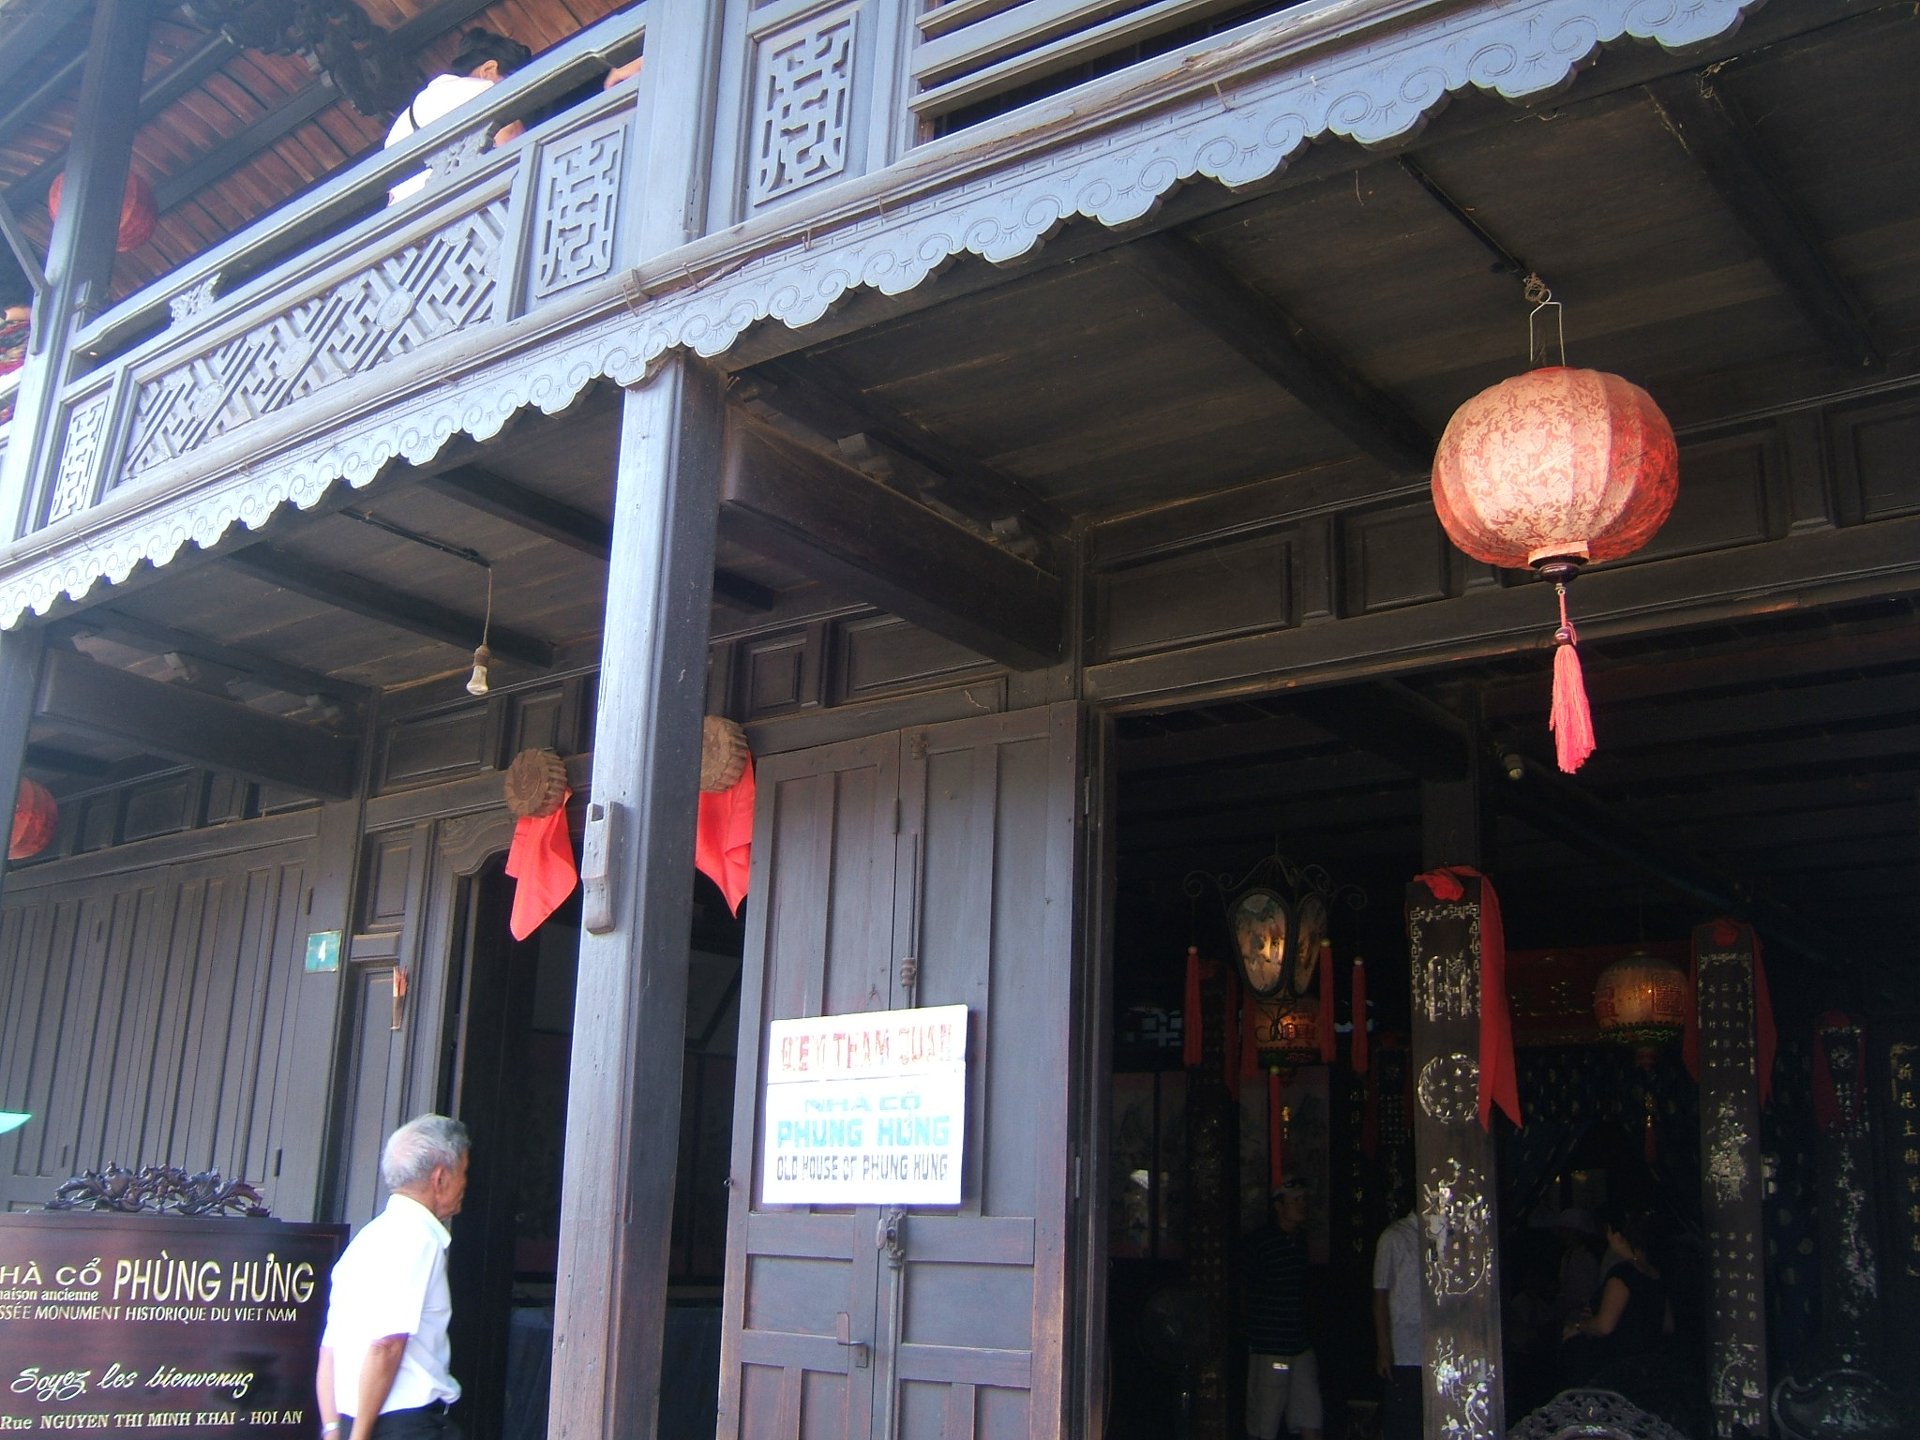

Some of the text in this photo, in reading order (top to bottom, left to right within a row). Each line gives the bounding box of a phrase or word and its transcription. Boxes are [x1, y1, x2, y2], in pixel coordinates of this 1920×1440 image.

[776, 1153, 948, 1181] OLD HOUSE OF PHUNG HUNG
[55, 1257, 102, 1286] CỔ
[113, 1249, 221, 1302] PHÙNG
[230, 1252, 315, 1303] HƯNG
[41, 1287, 99, 1301] ancienne
[34, 1305, 121, 1320] MONUMENT
[125, 1306, 206, 1324] HISTORIQUE
[210, 1307, 231, 1321] DU
[234, 1307, 263, 1321] VIET
[265, 1308, 297, 1322] NAM
[10, 1362, 254, 1402] Soyez les bienvenus
[0, 1415, 33, 1430] Rue
[40, 1414, 110, 1430] NGUYEN
[113, 1412, 144, 1428] THI
[147, 1411, 191, 1427] MINH
[195, 1411, 236, 1426] KHAI
[249, 1410, 278, 1425] HOI
[281, 1410, 303, 1425] AN
